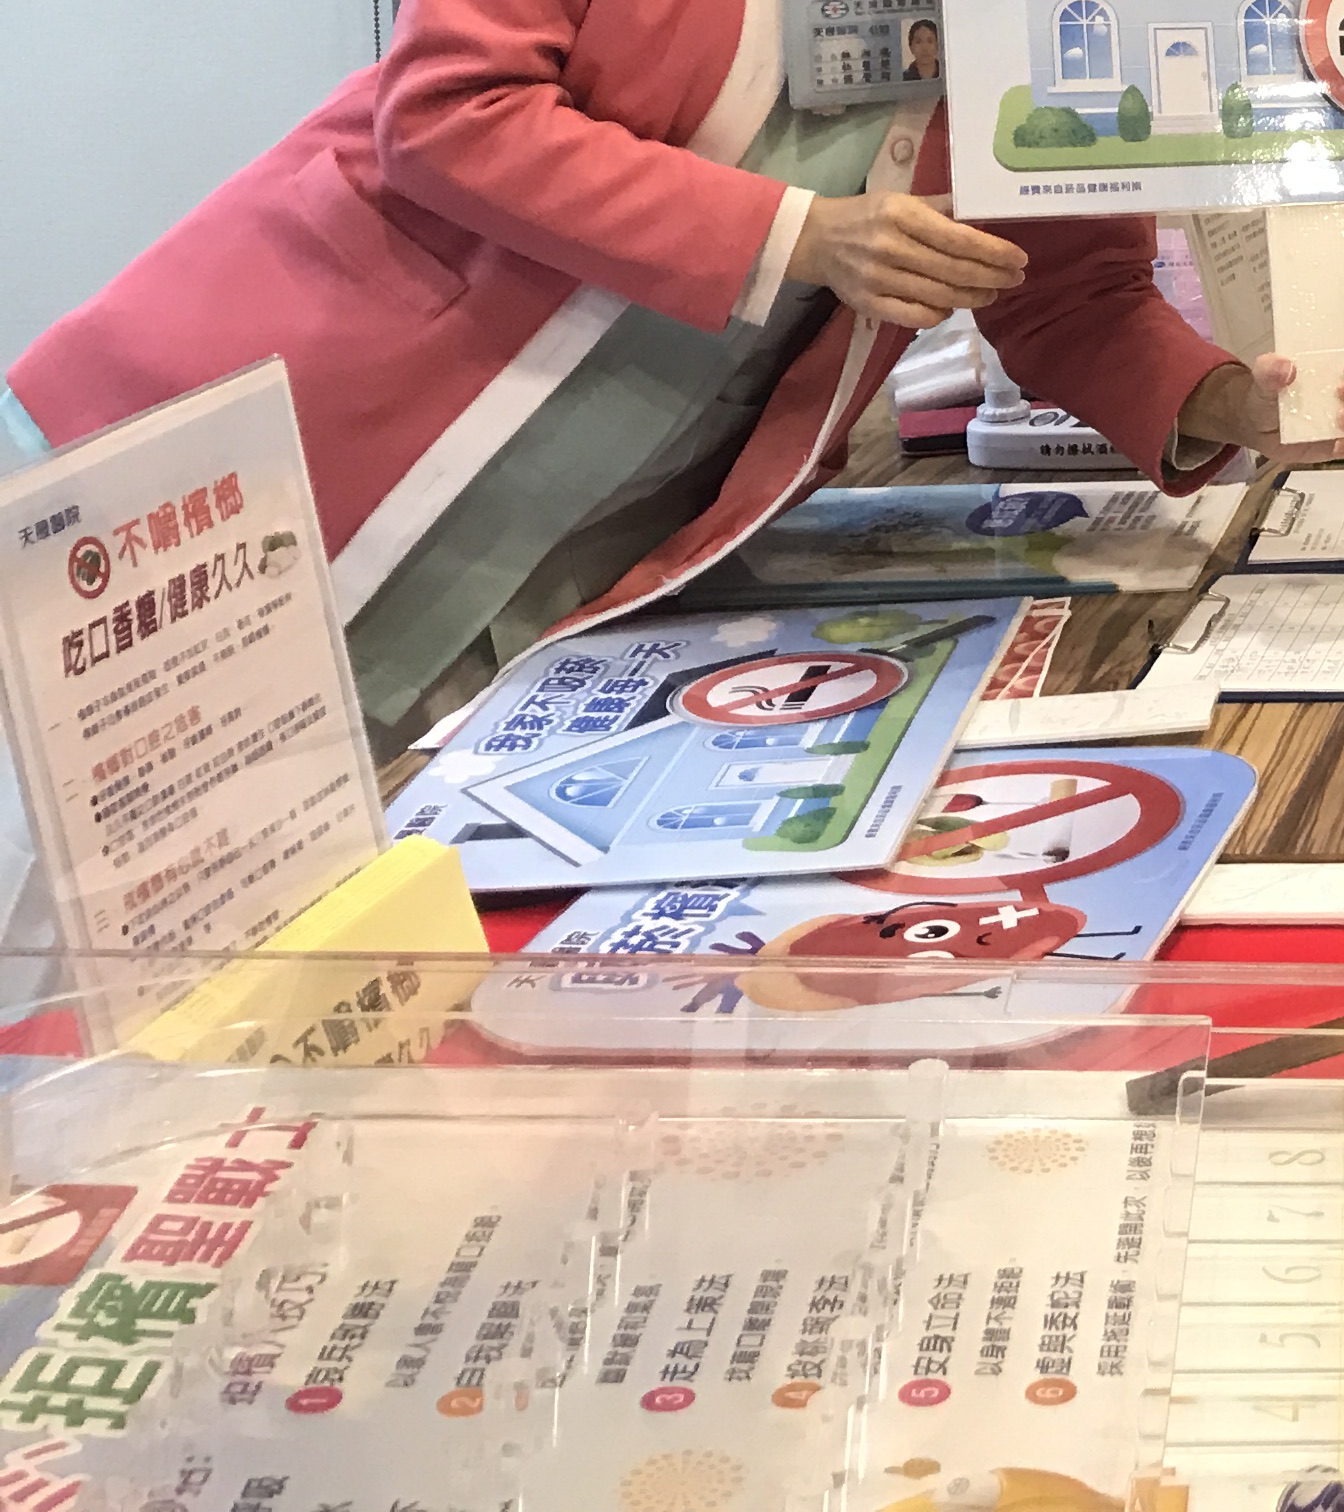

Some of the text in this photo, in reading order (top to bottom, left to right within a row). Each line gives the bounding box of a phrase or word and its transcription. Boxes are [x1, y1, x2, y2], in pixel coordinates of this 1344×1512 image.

[112, 471, 245, 569] 不嚼檳榔
[478, 654, 607, 756] 我家不吸菸
[563, 640, 687, 738] 健康每一天
[0, 1106, 322, 1512] 拒檳聖戰士
[912, 1272, 970, 1378] 安身立命法
